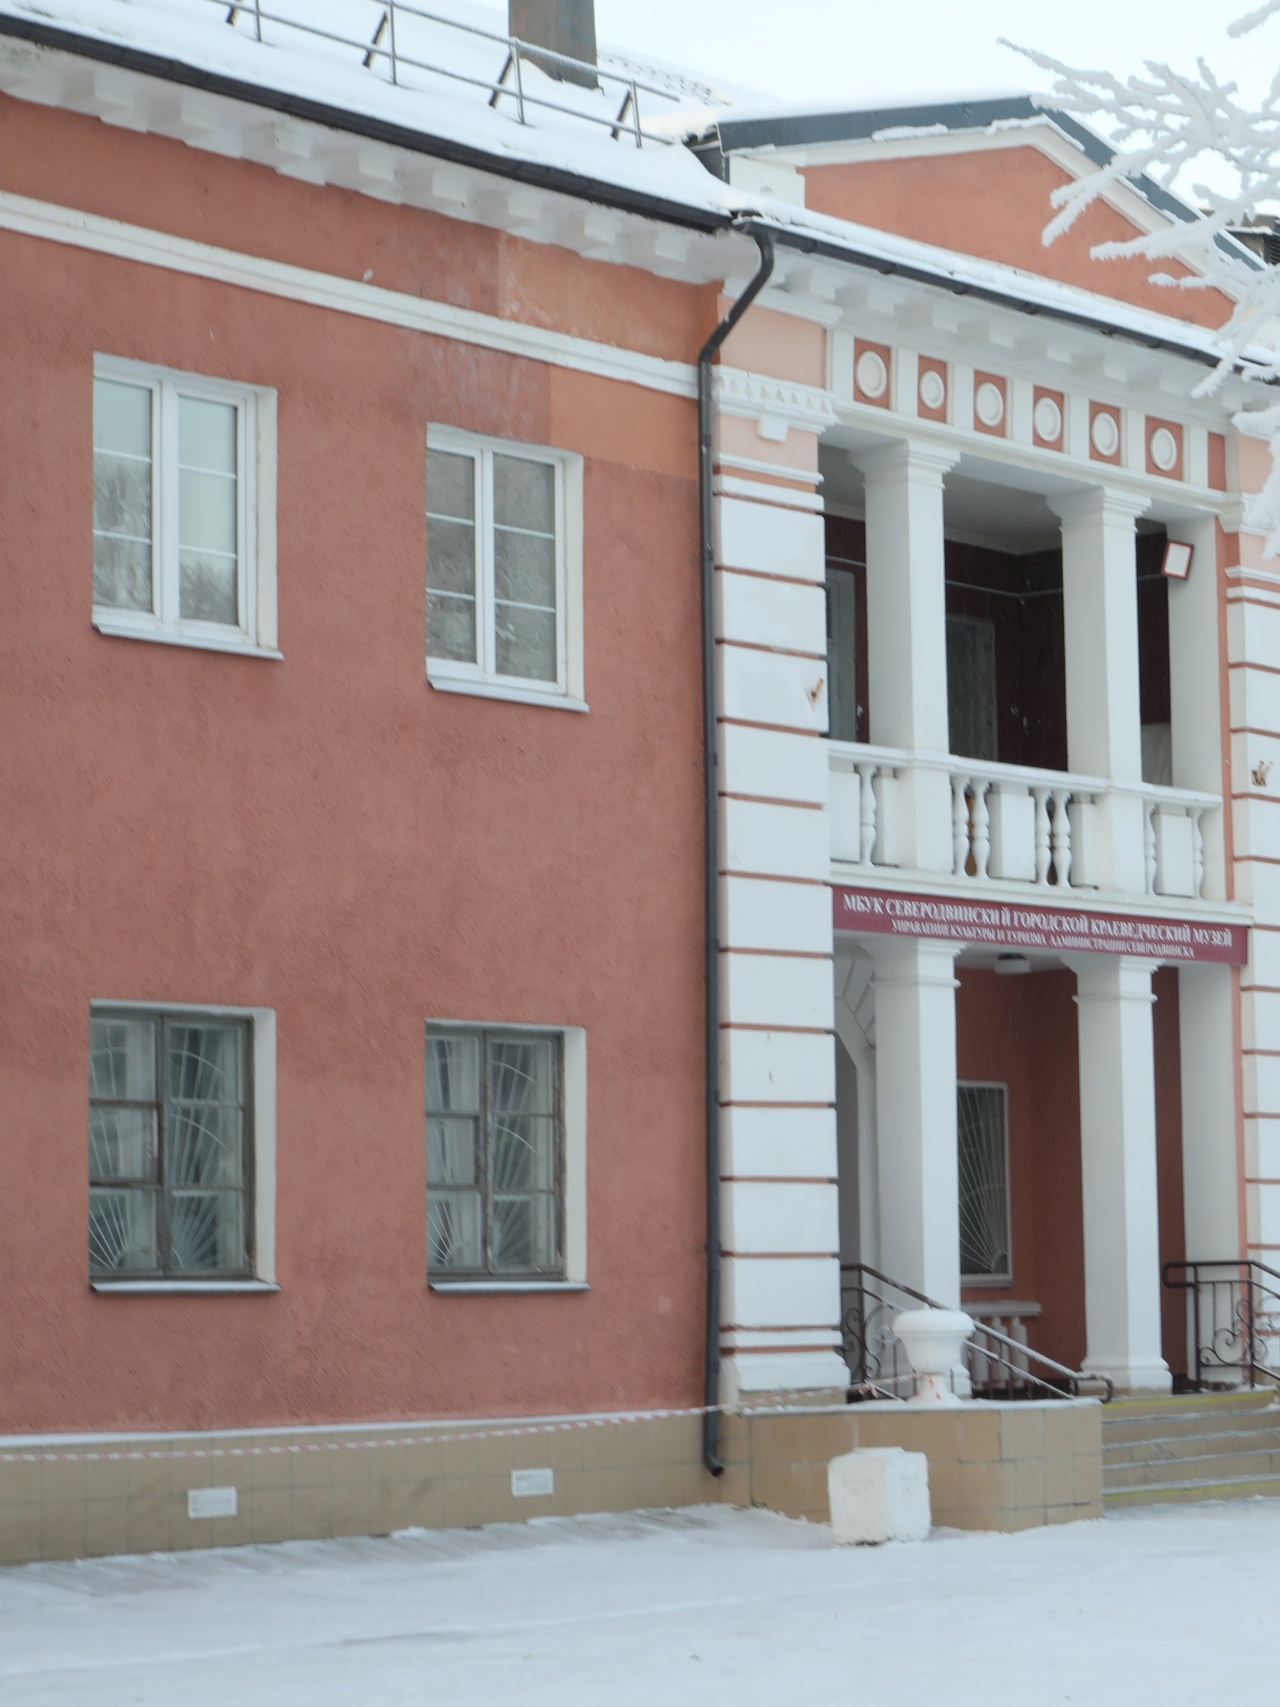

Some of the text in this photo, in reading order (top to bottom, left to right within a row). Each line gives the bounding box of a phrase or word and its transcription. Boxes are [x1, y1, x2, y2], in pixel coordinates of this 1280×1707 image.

[843, 893, 1233, 947] МБУК СЕВЕРОДВИНСКИЙ ГОРОДСКОЙ КРАЕВЕДЧЕСКИЙ МУЗЕЙ
